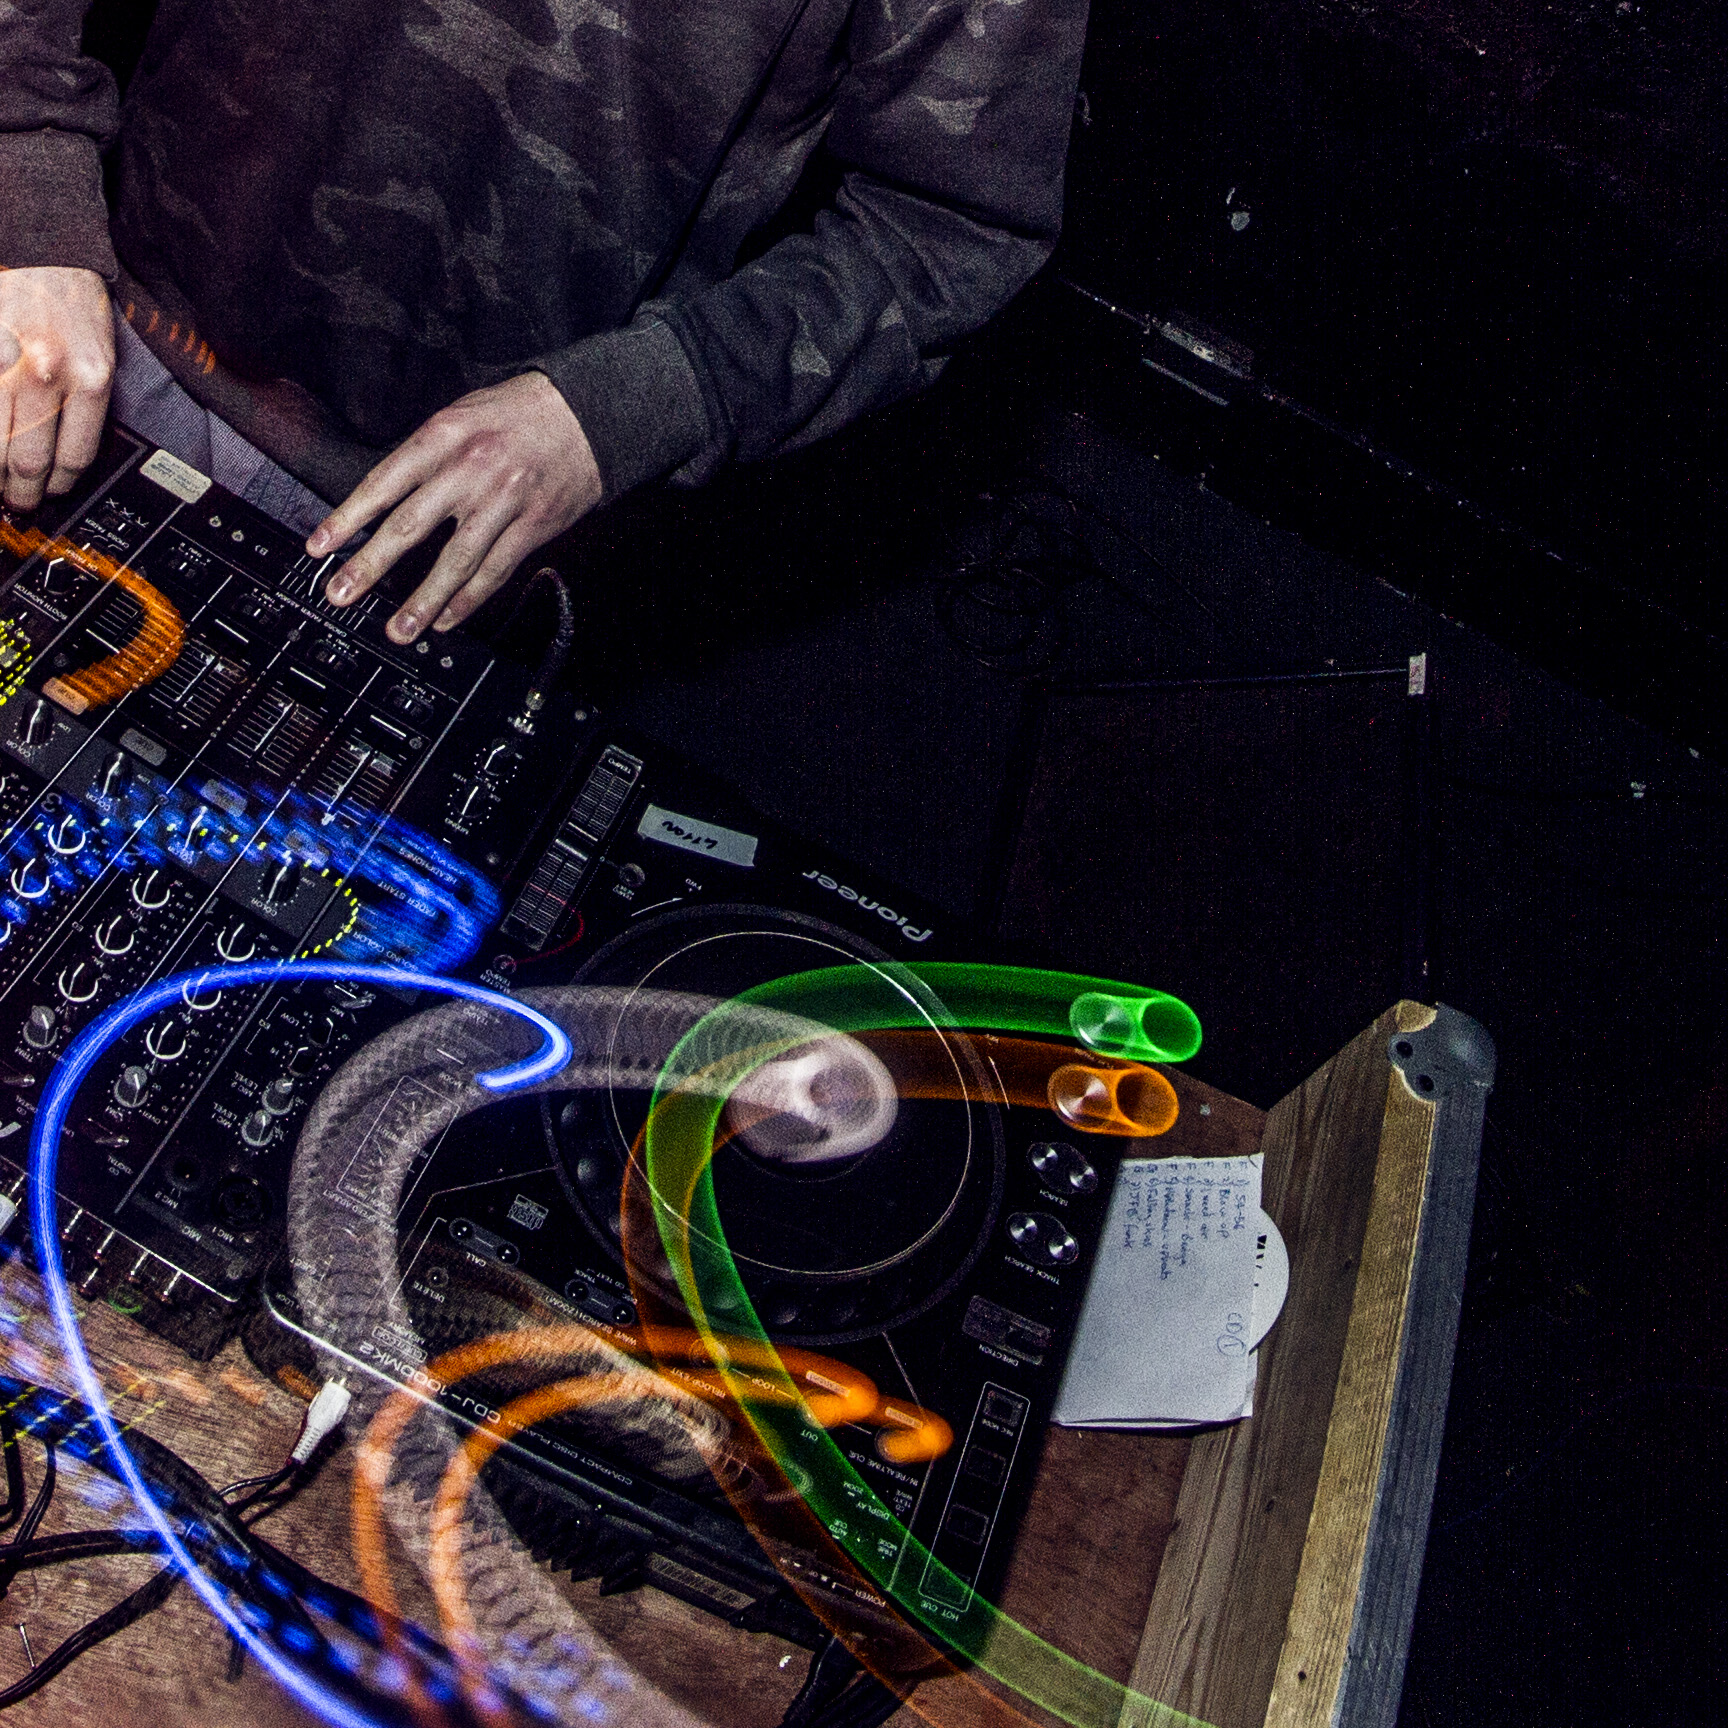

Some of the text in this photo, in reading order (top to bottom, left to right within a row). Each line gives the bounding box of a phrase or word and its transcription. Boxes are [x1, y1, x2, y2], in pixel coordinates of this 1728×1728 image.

[83, 514, 130, 550] CROSS FADER
[63, 544, 98, 572] CH FADER
[13, 580, 67, 622] BOOTH MONITOR
[274, 588, 347, 640] CROSS FADER ASSIGN
[4, 736, 31, 759] COLOR
[606, 755, 633, 775] TEMPO
[37, 787, 65, 816] 3
[84, 789, 111, 812] COLOR
[166, 842, 193, 865] COLOR
[397, 843, 458, 887] HEADPHONES
[683, 876, 703, 890] FWD
[250, 894, 278, 918] COLOR
[376, 878, 436, 919] FADER START
[801, 865, 934, 944] Pioneer
[70, 919, 84, 932] EQ
[357, 932, 419, 975] SOUND COLOR
[479, 971, 511, 995] MASTER
[483, 967, 512, 989] TEMPO
[279, 1010, 300, 1027] LOW
[328, 1003, 345, 1018] MIC
[257, 1017, 272, 1030] EQ
[13, 1044, 35, 1063] TRIM
[231, 1069, 259, 1090] LEVEL
[236, 1083, 254, 1097] MIC
[210, 1100, 238, 1121] LEVEL
[216, 1114, 233, 1128] MIC
[322, 1187, 352, 1209] ADJUST
[1037, 1187, 1069, 1206] SEARCH
[463, 1250, 487, 1268] CALL
[1002, 1254, 1061, 1285] TRACK SEARCH
[572, 1267, 597, 1283] TRACK
[595, 1270, 626, 1289] CD TEXT
[410, 1280, 446, 1303] DELETE
[612, 1328, 638, 1346] WAVE
[977, 1342, 1020, 1367] DIRECTION
[353, 1339, 506, 1425] CDJ-1000MK2
[668, 1365, 727, 1398] RELOOP/EXIT
[750, 1374, 776, 1392] LOOP
[799, 1427, 819, 1442] OUT
[980, 1417, 1014, 1436] REC MODE
[505, 1418, 635, 1485] COMPACT DISC PLAYER
[847, 1448, 920, 1486] IN/REALTIME CUE
[841, 1479, 865, 1495] ZOOM
[893, 1487, 914, 1502] WAVE
[854, 1499, 891, 1521] DISPLAY
[894, 1502, 906, 1512] CD
[827, 1522, 848, 1537] AUTO
[832, 1517, 848, 1529] CUE
[876, 1537, 898, 1551] MODE
[853, 1588, 886, 1607] POWER
[919, 1599, 960, 1621] HOT CUE
